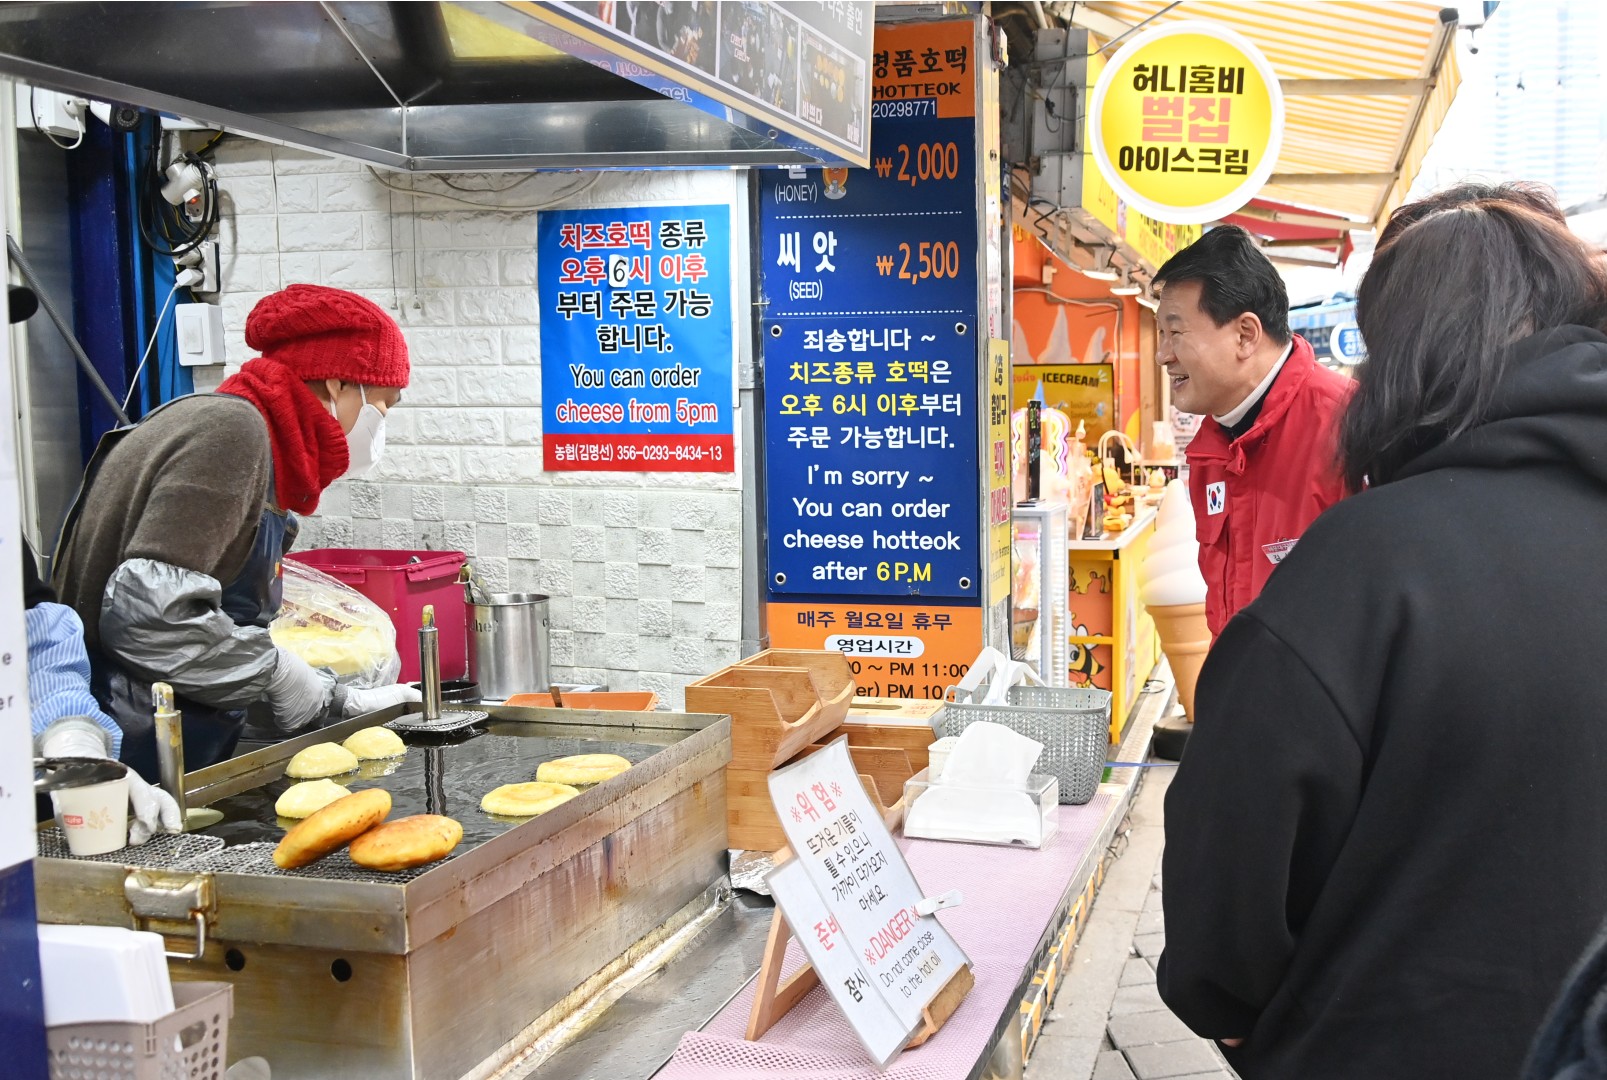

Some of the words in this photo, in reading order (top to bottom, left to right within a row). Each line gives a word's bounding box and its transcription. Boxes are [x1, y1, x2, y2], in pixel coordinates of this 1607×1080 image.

[872, 82, 961, 98] HOTTEOK
[1133, 64, 1245, 94] 허니홈비
[1142, 96, 1231, 144] 벌집
[1119, 146, 1249, 175] 아이스크림
[775, 182, 817, 204] (HONEY)
[560, 222, 651, 251] 치즈호떡
[659, 220, 706, 248] 종류
[660, 254, 707, 282] 이후
[789, 280, 823, 301] (SEED)
[556, 291, 601, 319] 부터
[610, 291, 656, 319] 주문
[664, 289, 712, 318] 가능
[596, 325, 673, 353] 합니다.
[803, 328, 912, 352] 죄송합니다
[569, 364, 605, 388] You
[610, 369, 645, 388] can
[651, 363, 701, 388] order
[789, 361, 877, 385] 치즈종류
[885, 360, 952, 384] 호떡은
[1042, 372, 1100, 387] ICECREAM
[556, 398, 624, 423] cheese
[629, 398, 671, 423] from
[676, 398, 718, 426] 5pm
[779, 394, 823, 416] 오후
[832, 393, 867, 416] 6시
[877, 393, 961, 416] 이후부터
[787, 427, 831, 449] 주문
[840, 426, 955, 449] 가능합니다.
[555, 444, 614, 461] 농협(김명선)
[617, 445, 722, 460] 356-0293-8434-13
[807, 464, 842, 485] I'm
[852, 470, 909, 489] sorry
[792, 498, 832, 517] You
[841, 502, 882, 517] can
[891, 499, 950, 518] order
[783, 529, 863, 549] cheese
[873, 530, 960, 550] hotteok
[812, 561, 867, 581] after
[797, 610, 836, 628] 매주
[845, 611, 904, 630] 월요일
[912, 612, 952, 630] 휴무
[837, 639, 913, 654] 영업시간
[890, 662, 914, 676] PM
[922, 664, 969, 678] 11:00
[888, 684, 914, 699] PM
[806, 827, 839, 855] 뜨거운
[833, 809, 862, 835] 기름이
[832, 873, 859, 902] 가까이
[855, 850, 889, 882] 다가오지
[858, 885, 889, 911] 마세요.
[880, 972, 894, 987] Do
[891, 960, 905, 978] not
[902, 946, 920, 966] come
[917, 931, 934, 950] close
[844, 968, 870, 1003] 잠시
[900, 985, 911, 999] to
[907, 973, 922, 989] the
[917, 960, 934, 978] hot
[931, 950, 942, 966] oil
